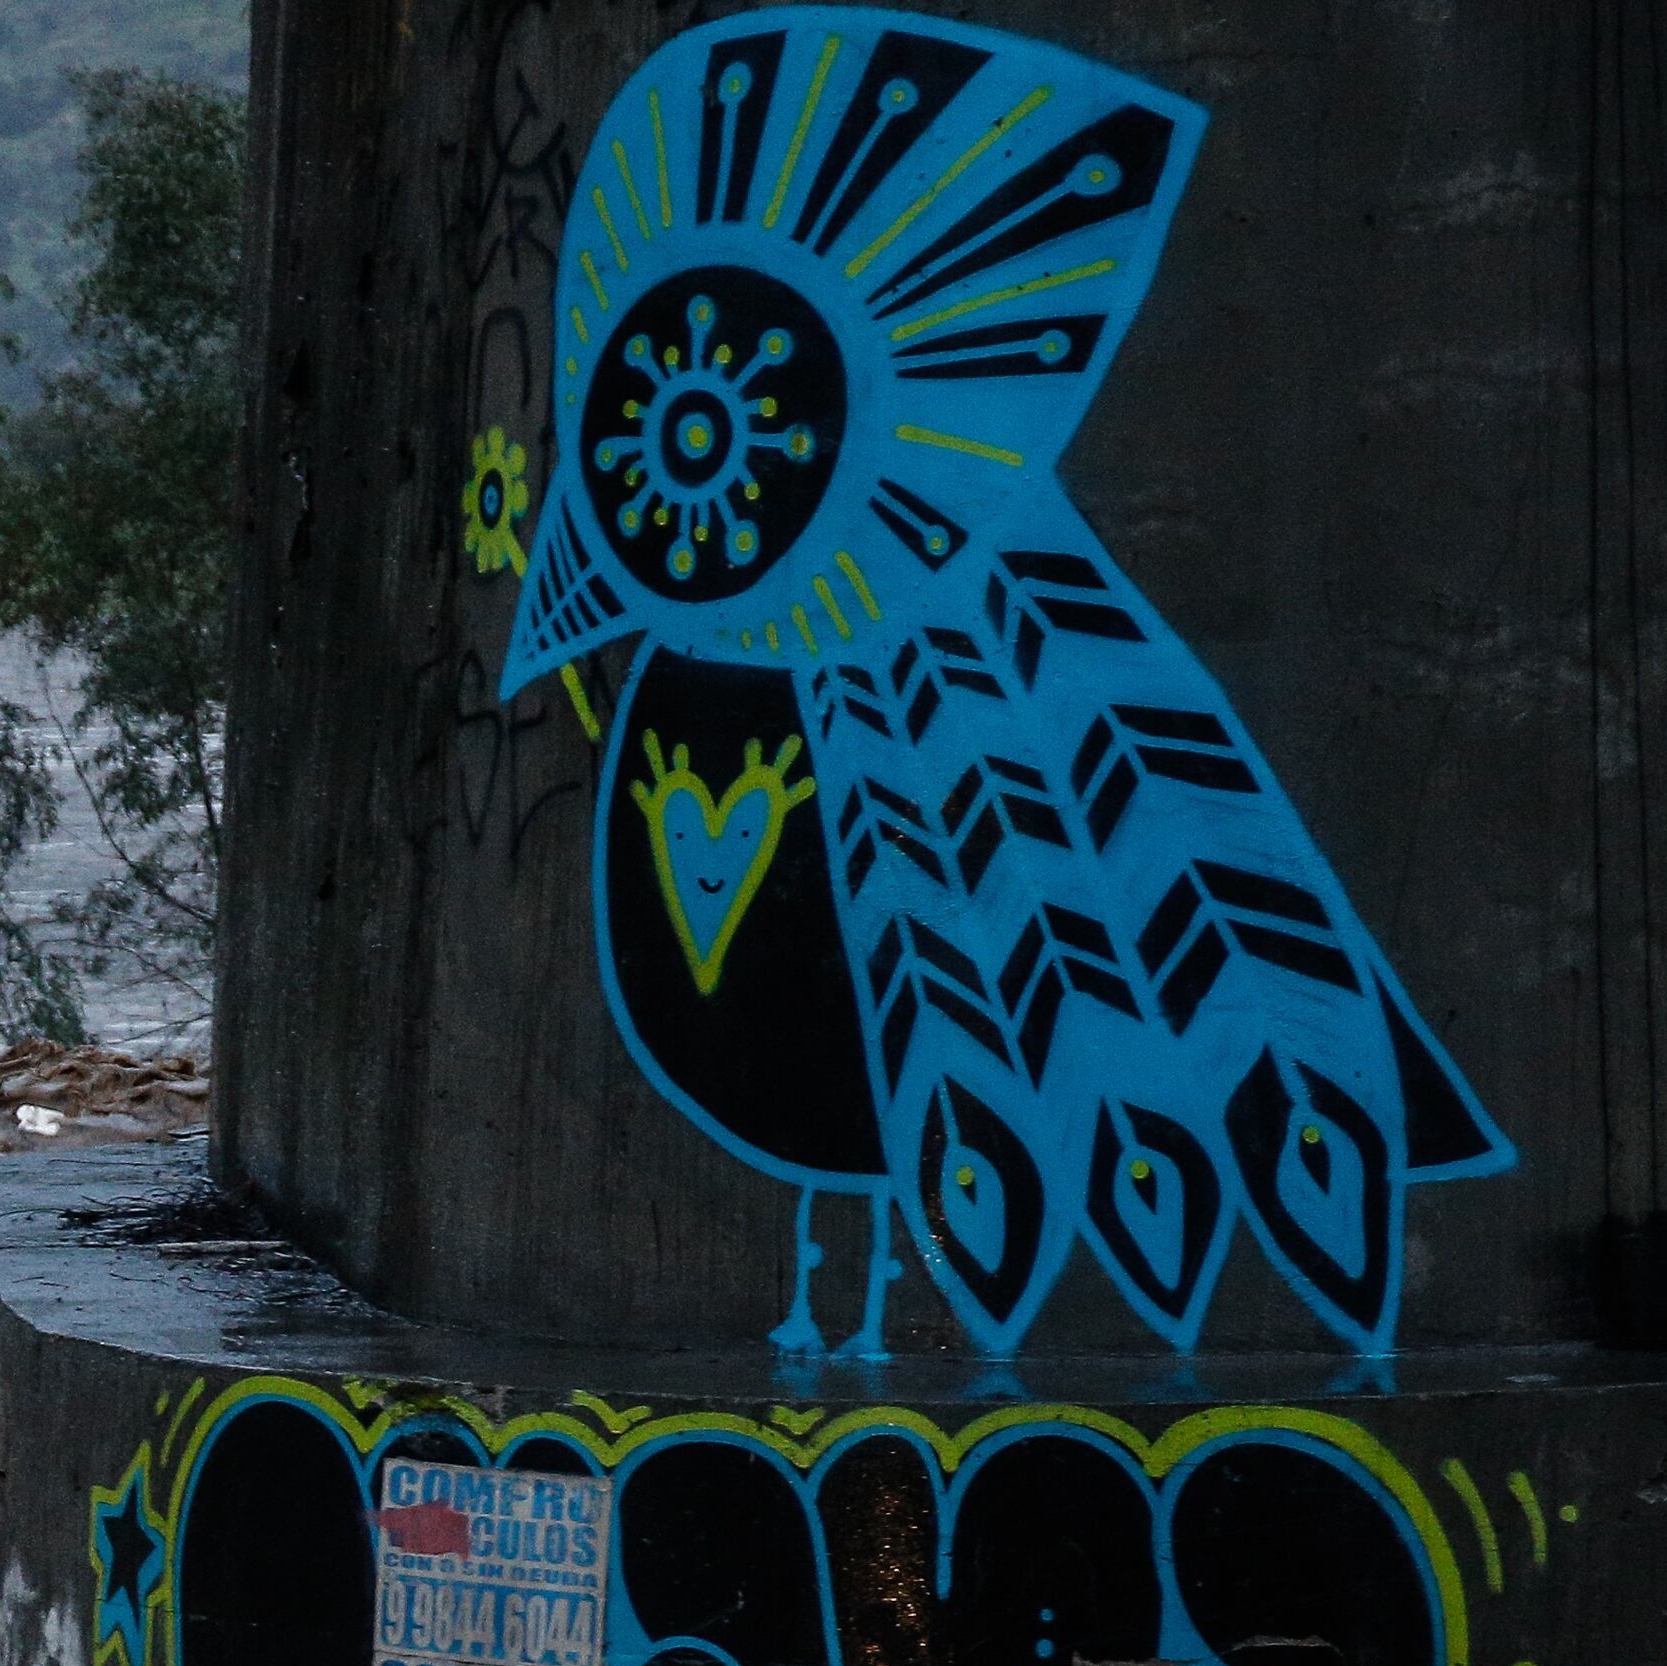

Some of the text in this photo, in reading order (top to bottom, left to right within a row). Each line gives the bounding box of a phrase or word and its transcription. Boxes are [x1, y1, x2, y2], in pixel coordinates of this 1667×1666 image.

[389, 1465, 603, 1524] COMPRO
[384, 1552, 432, 1571] CON
[462, 1561, 504, 1578] SIN
[386, 1509, 597, 1566] CULOS
[381, 1581, 593, 1666] 9 9844 6044
